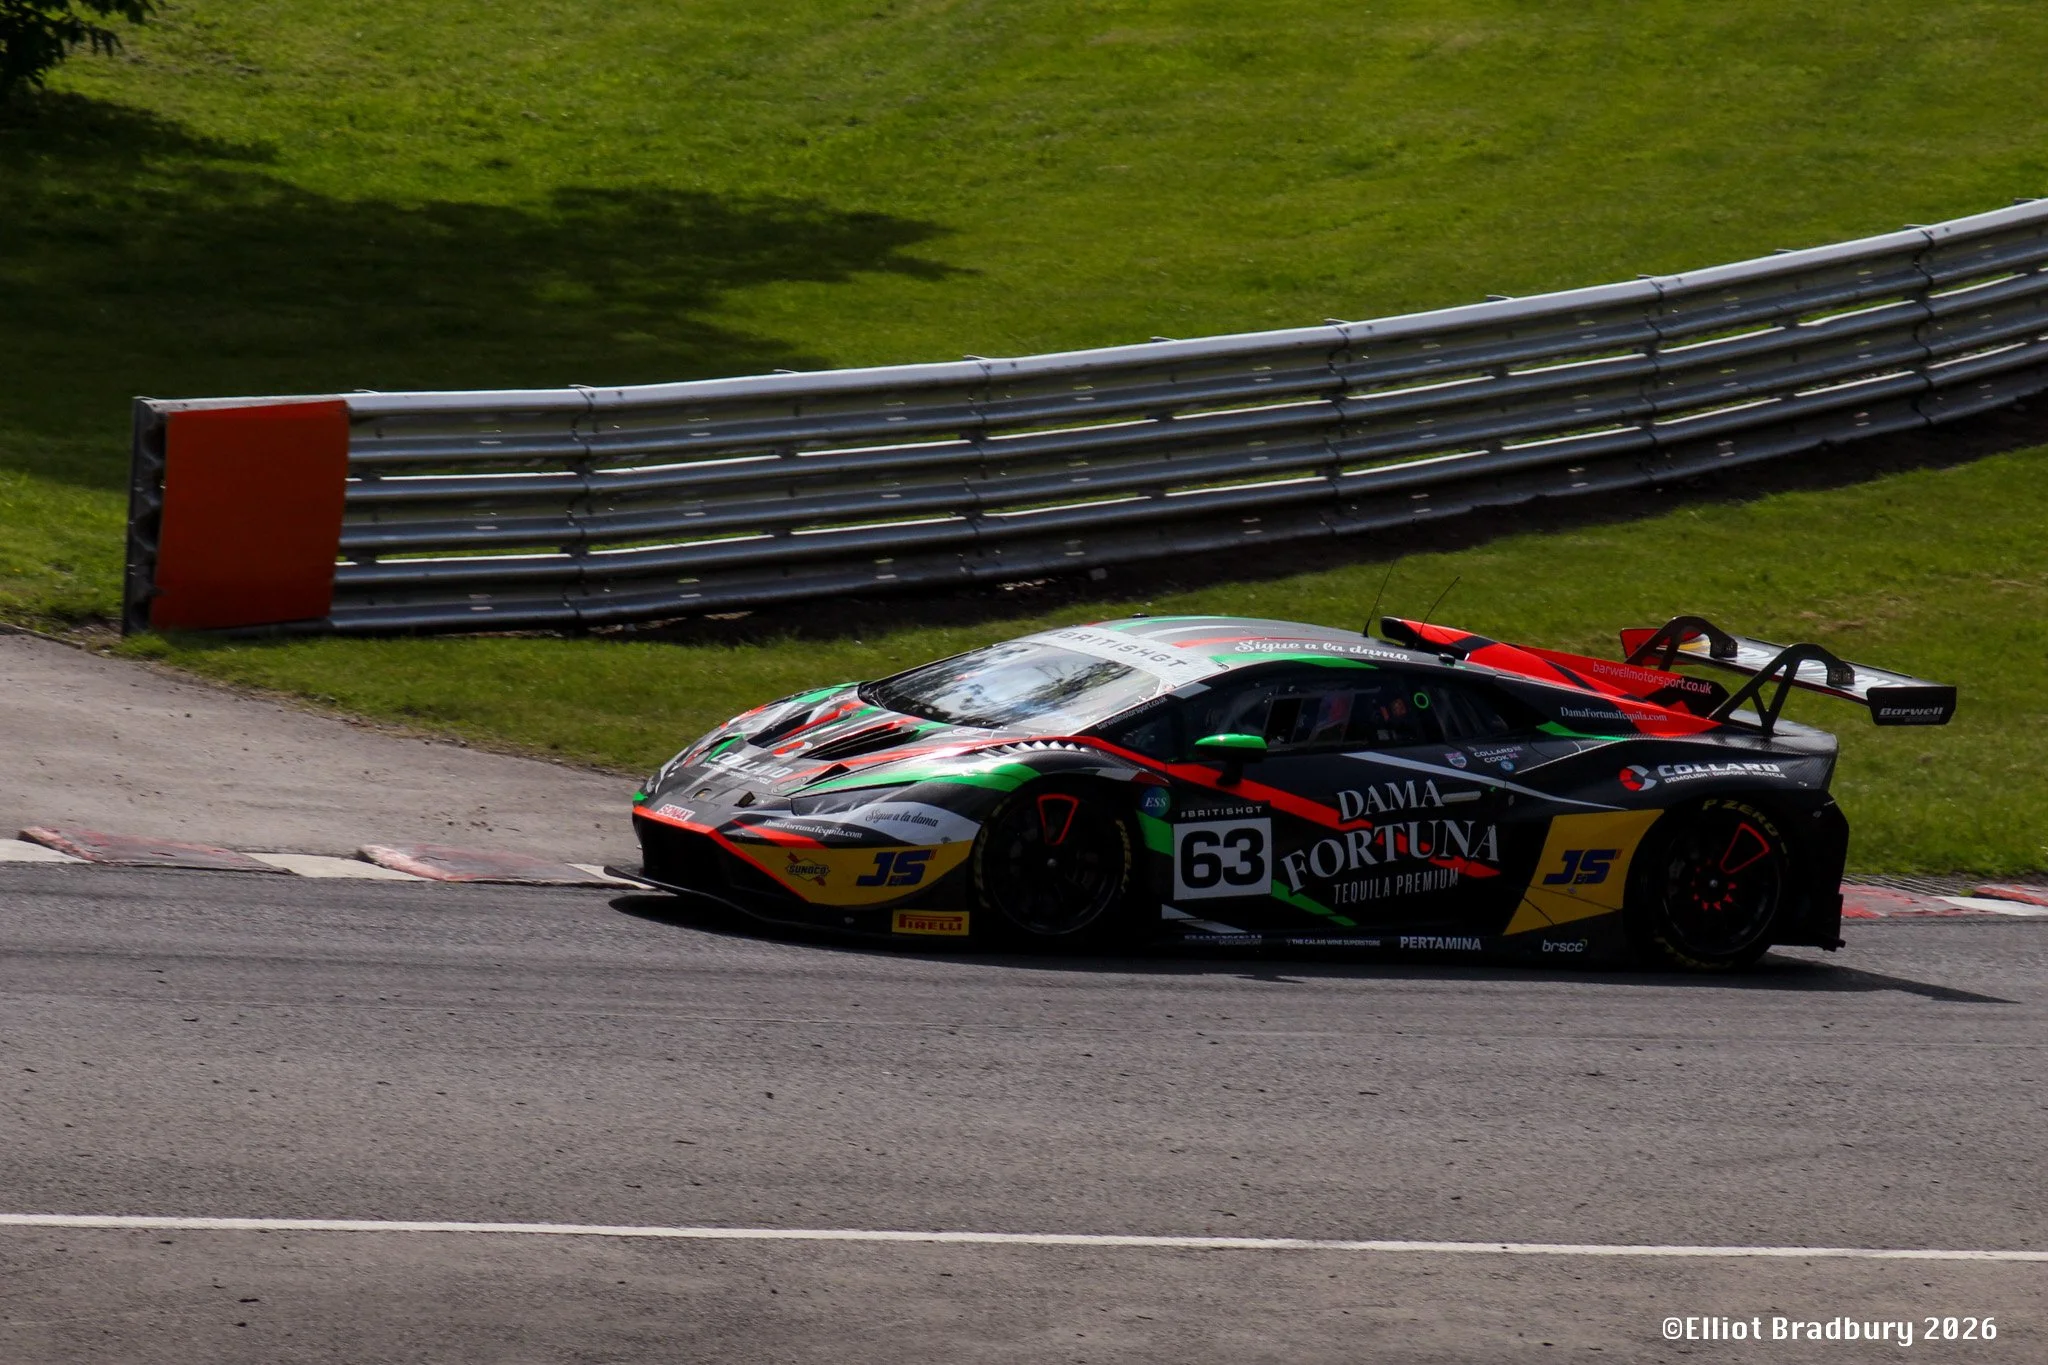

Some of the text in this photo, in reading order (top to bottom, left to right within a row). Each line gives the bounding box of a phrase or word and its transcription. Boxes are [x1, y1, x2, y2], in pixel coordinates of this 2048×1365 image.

[1235, 640, 1300, 653] Sigue
[1322, 642, 1346, 652] la
[1349, 645, 1410, 661] dama
[1592, 661, 1713, 695] barwellmotorsport.co.uk
[1560, 706, 1669, 722] DamaFortunaTequila.com
[1879, 707, 1943, 716] Barwell
[1474, 747, 1513, 757] COLLARD
[1484, 755, 1509, 763] COOK
[1657, 763, 1781, 775] COLLARD
[1145, 797, 1167, 808] ESS
[1336, 779, 1445, 821] DAMA
[661, 805, 691, 820] SONAX
[865, 809, 892, 825] Sigue
[900, 812, 910, 822] la
[911, 815, 939, 828] dama
[1181, 805, 1263, 819] #BRITISHGT
[1181, 828, 1265, 888] 63
[1280, 819, 1500, 893] FORTUNA
[788, 864, 827, 874] SUNOCO
[857, 850, 936, 886] JS
[1543, 849, 1622, 885] JS
[1334, 867, 1459, 904] TEQUILA PREMIUM
[899, 913, 963, 931] PIRELLI
[1400, 936, 1482, 950] PERTAMINA
[1542, 939, 1583, 952] brscc
